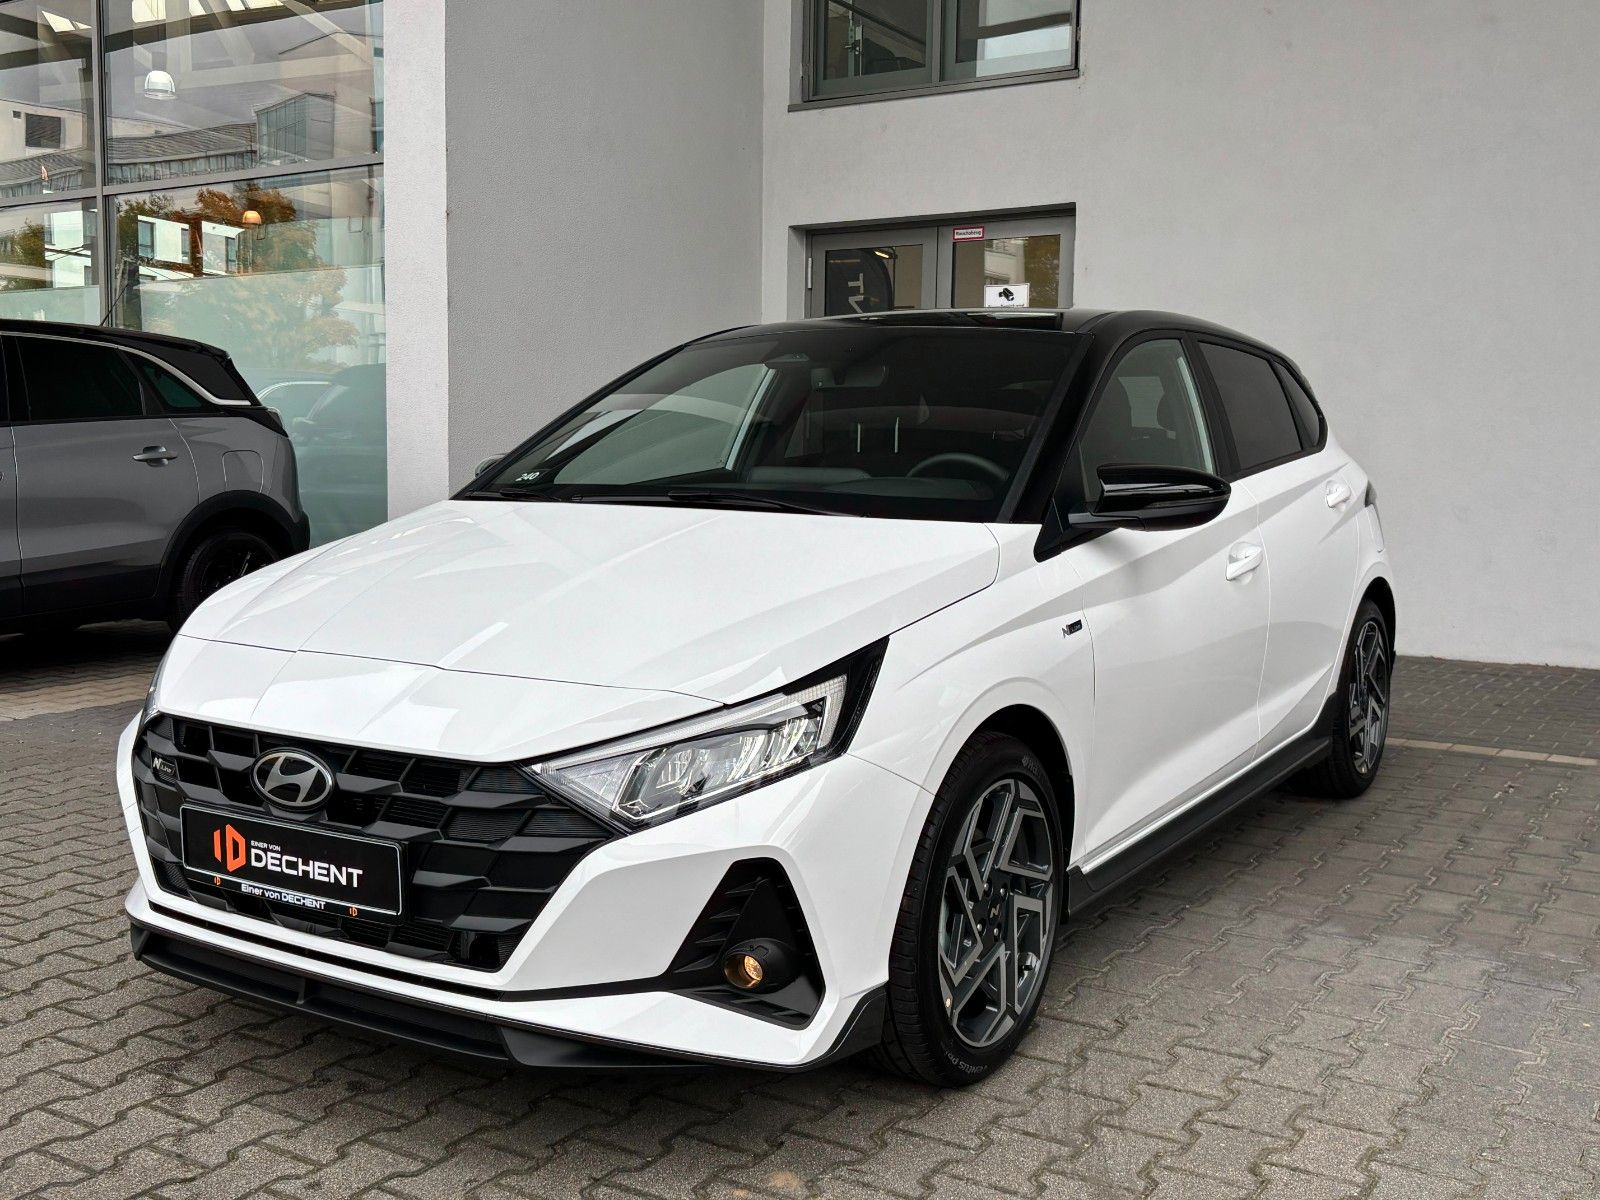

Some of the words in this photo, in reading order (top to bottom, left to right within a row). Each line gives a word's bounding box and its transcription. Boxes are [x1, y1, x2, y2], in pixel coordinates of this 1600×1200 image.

[250, 840, 267, 849] EINER
[268, 843, 281, 852] VON
[250, 848, 363, 888] DECHENT
[241, 883, 263, 897] Einer
[264, 889, 280, 900] von
[281, 891, 326, 910] DECHENT
